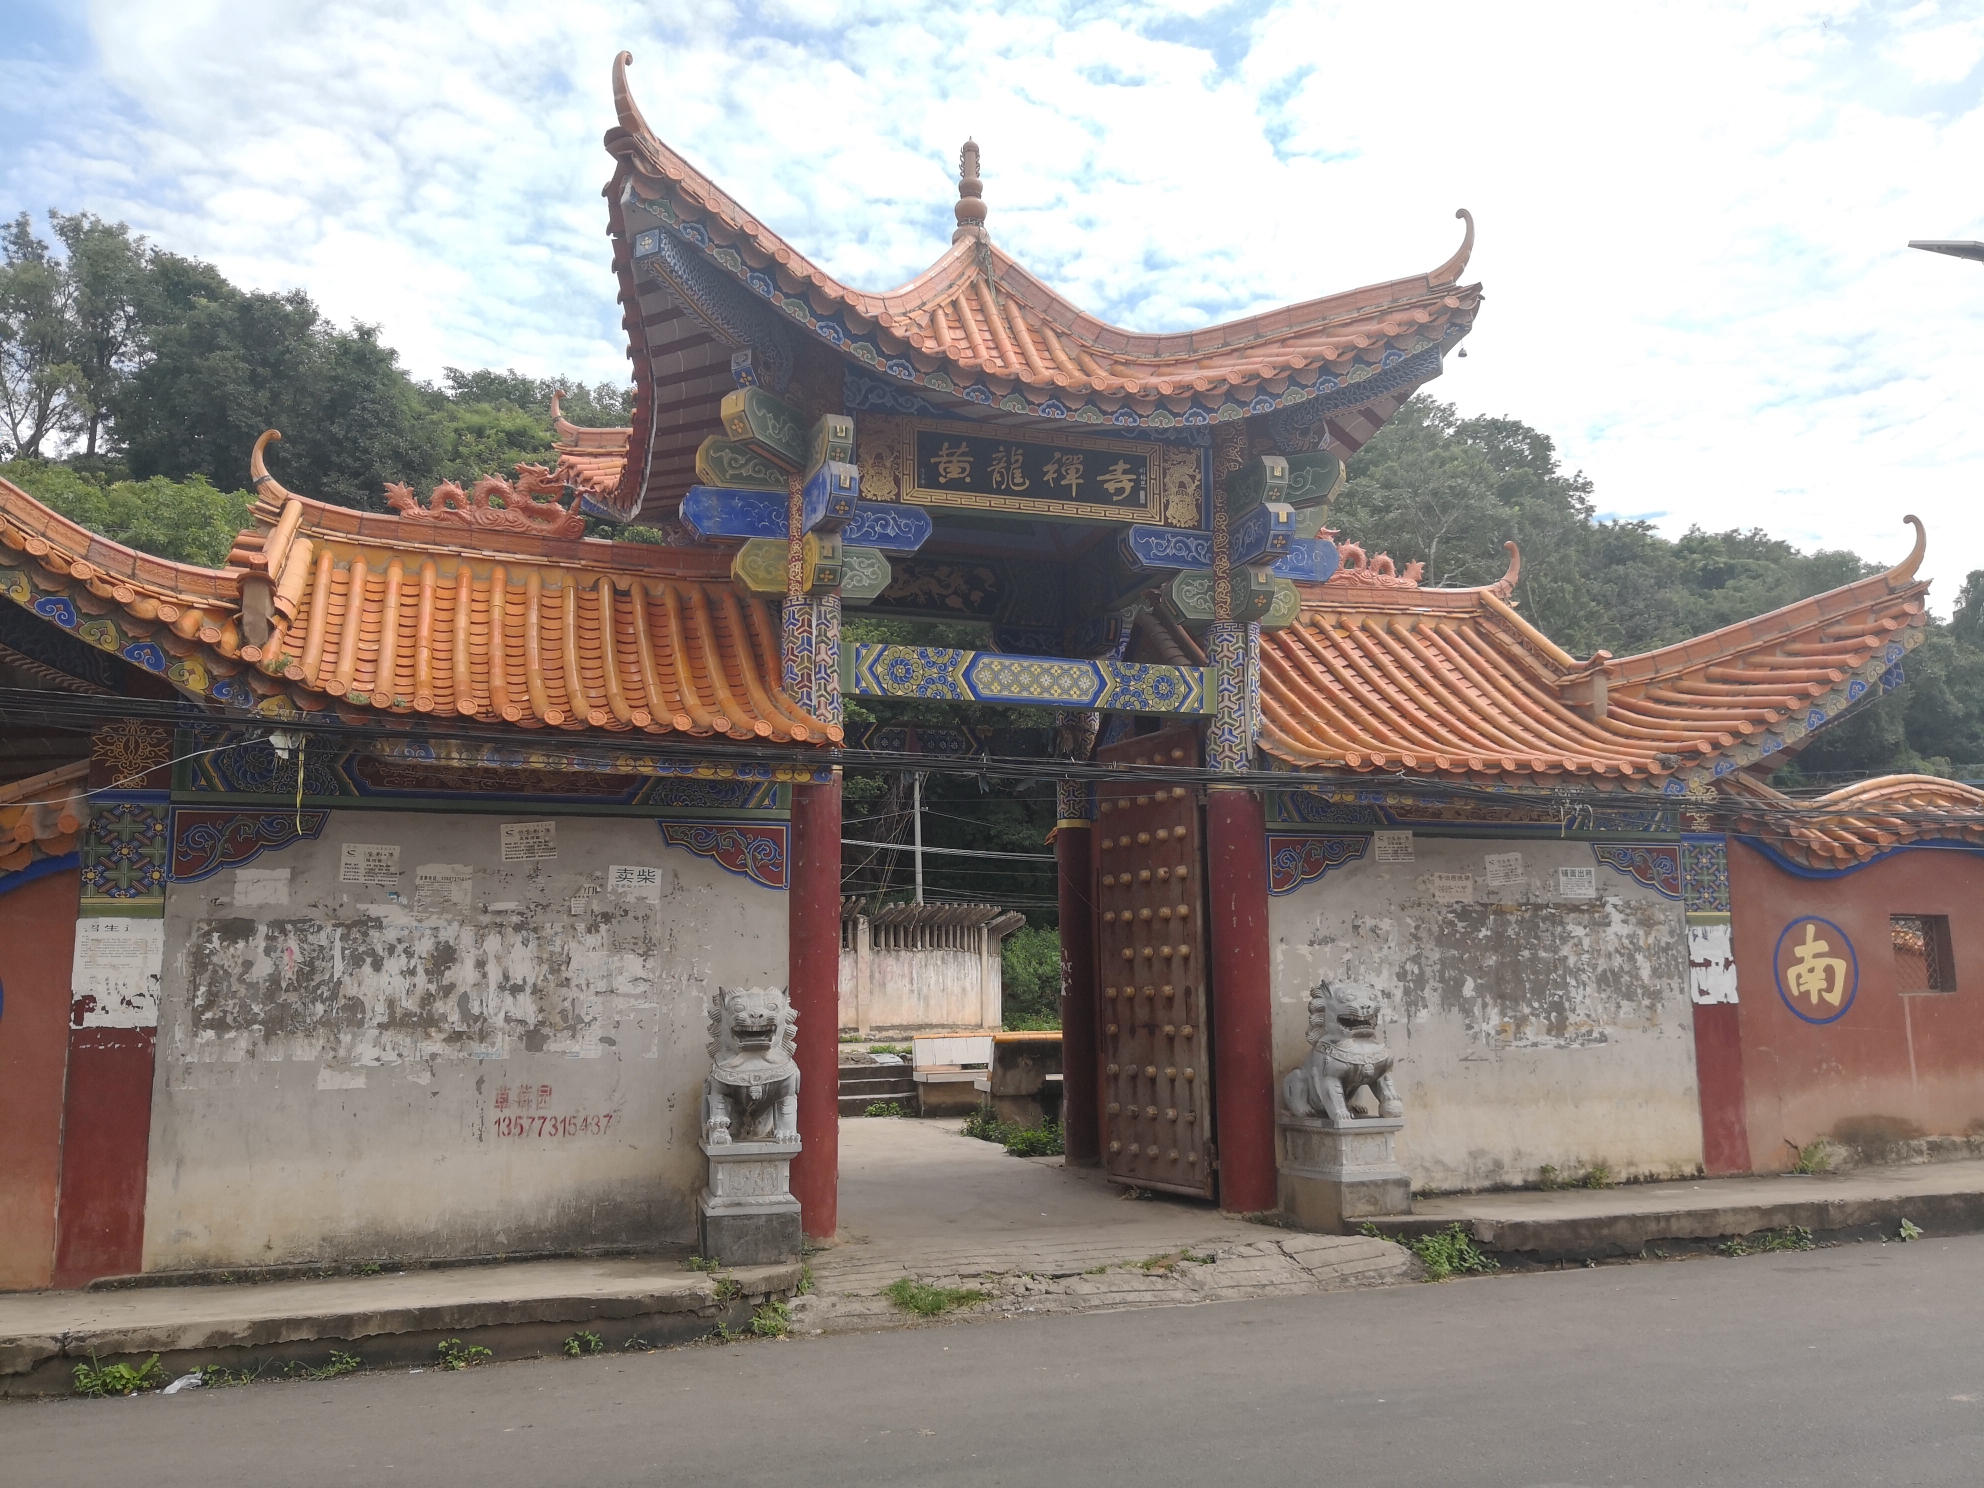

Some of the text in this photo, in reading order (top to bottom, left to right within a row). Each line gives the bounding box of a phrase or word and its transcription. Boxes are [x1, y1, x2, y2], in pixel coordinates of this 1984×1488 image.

[615, 867, 656, 884] 卖柴
[1787, 924, 1846, 1007] 南
[494, 1113, 613, 1138] 13577315437
